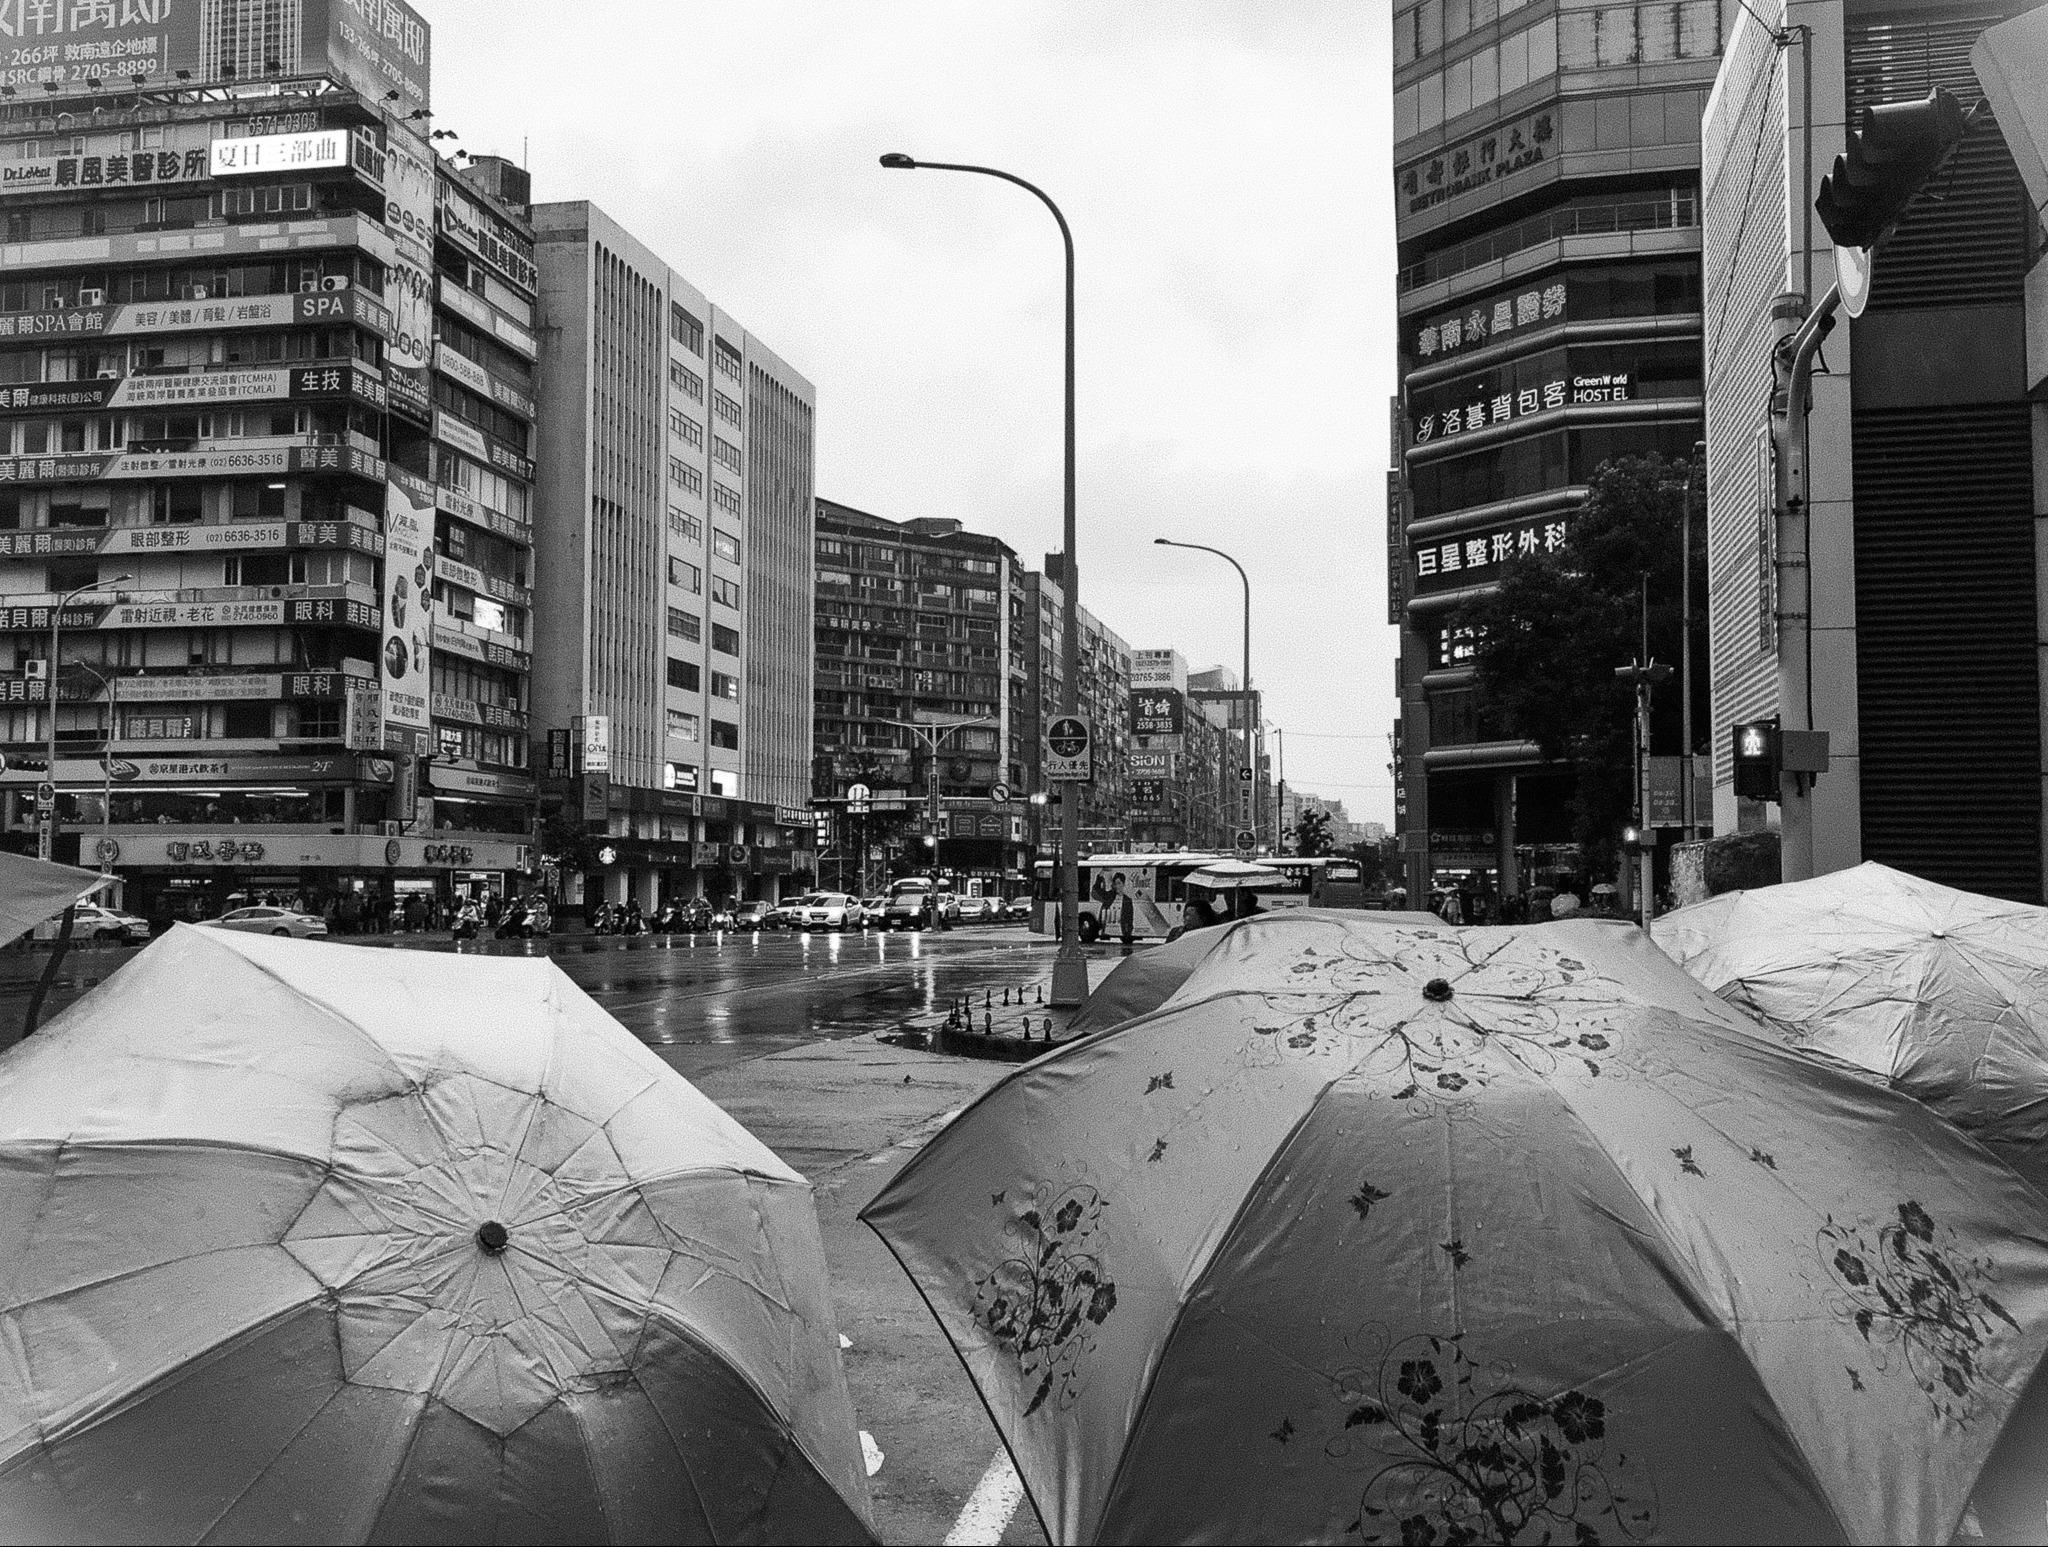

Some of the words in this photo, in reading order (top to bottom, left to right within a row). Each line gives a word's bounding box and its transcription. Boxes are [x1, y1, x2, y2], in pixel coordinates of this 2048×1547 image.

[71, 59, 157, 81] 2705-8899
[219, 138, 336, 168] 夏日三部曲
[55, 149, 207, 187] 順風美醫診所
[303, 296, 344, 317] SPA
[301, 369, 341, 391] 生技
[1573, 388, 1629, 404] HOSTEL
[300, 448, 339, 468] 醫美
[131, 531, 190, 548] 眼部整形
[298, 523, 337, 544] 醫美
[1417, 521, 1567, 577] 巨星整形外科
[295, 601, 335, 621] 眼科
[292, 676, 331, 696] 眼科
